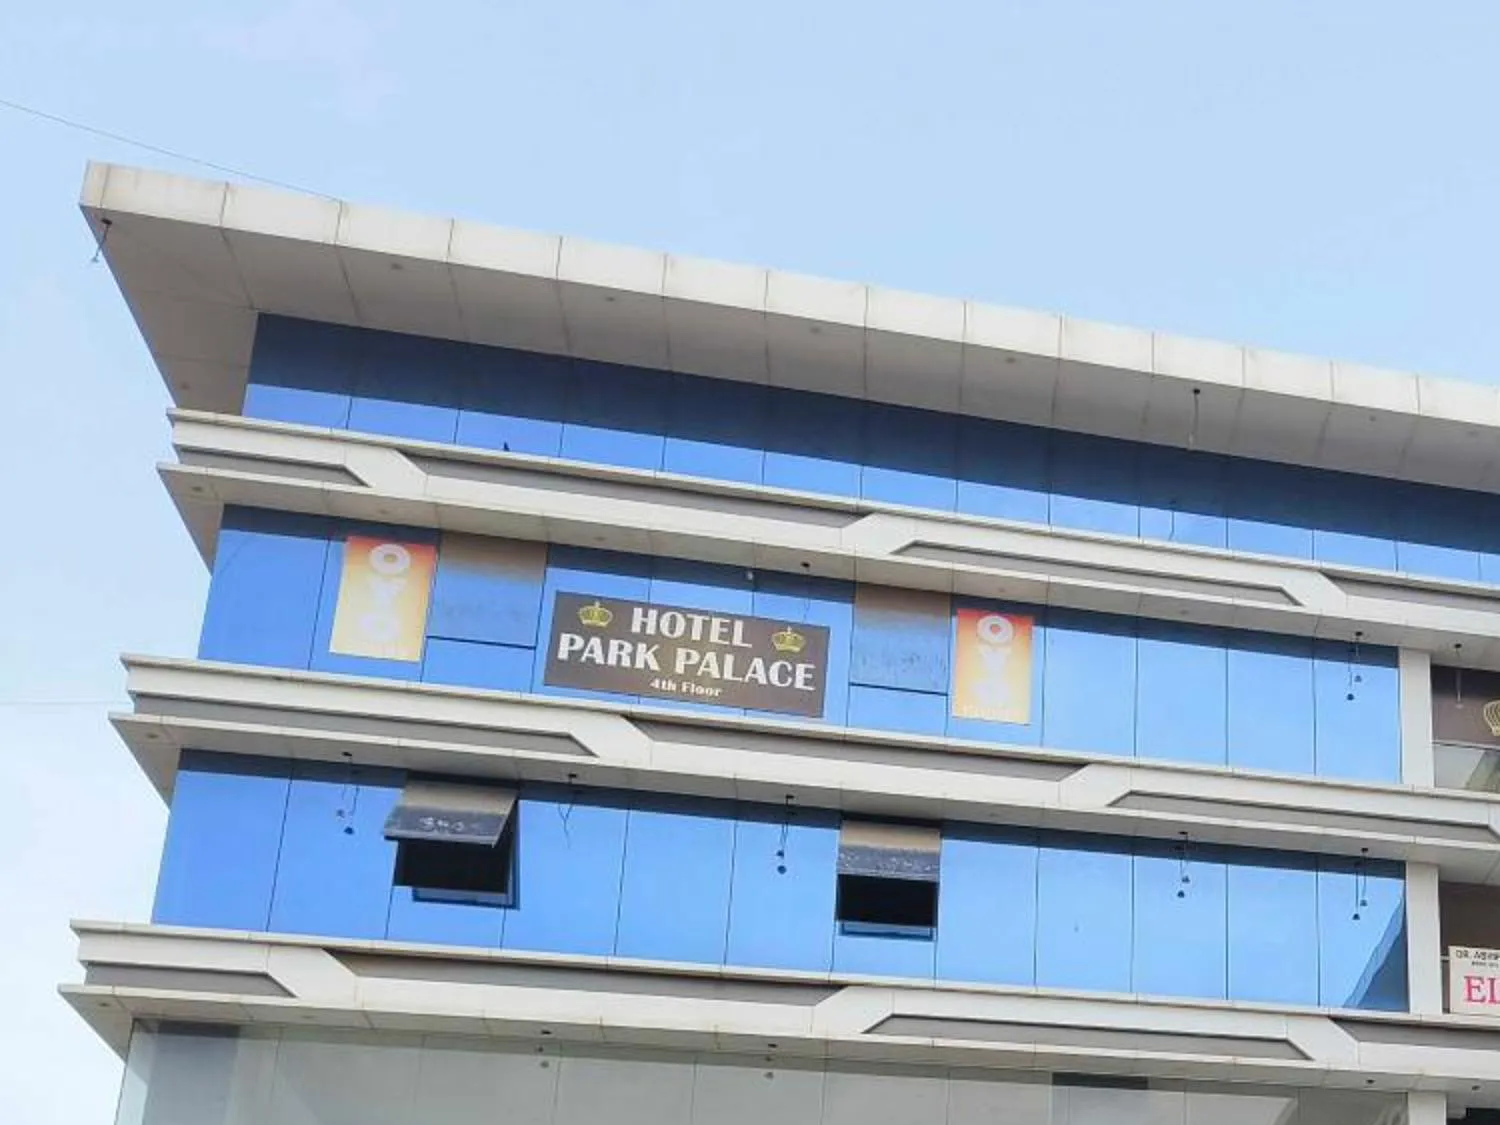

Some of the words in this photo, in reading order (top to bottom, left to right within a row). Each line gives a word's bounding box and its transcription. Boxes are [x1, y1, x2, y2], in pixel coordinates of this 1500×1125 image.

[631, 607, 752, 649] HOTEL
[557, 633, 661, 673] PARK
[675, 647, 816, 691] PALACE
[650, 678, 677, 693] 4th
[681, 681, 723, 697] Floor
